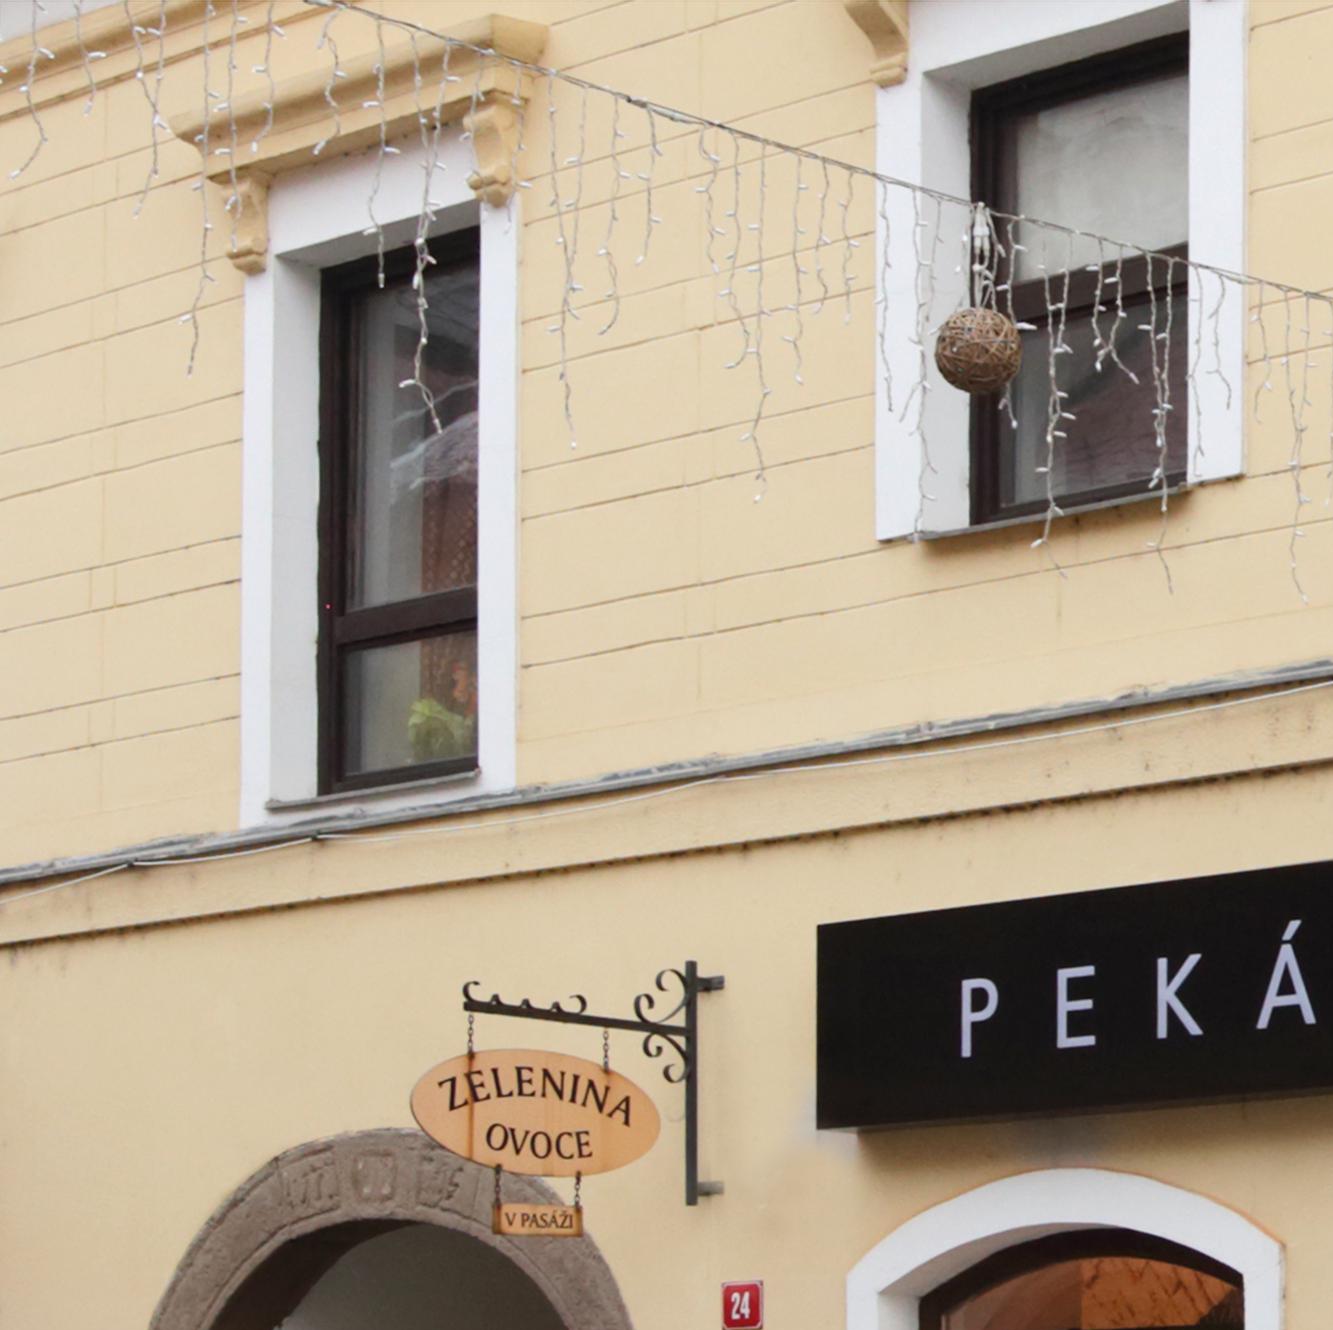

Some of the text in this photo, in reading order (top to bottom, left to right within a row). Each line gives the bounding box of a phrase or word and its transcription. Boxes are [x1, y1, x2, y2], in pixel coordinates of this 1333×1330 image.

[438, 1066, 632, 1127] ZELENINA
[486, 1123, 593, 1160] OVOCE
[505, 1208, 574, 1229] V PASÁŽI
[731, 1291, 750, 1320] 24
